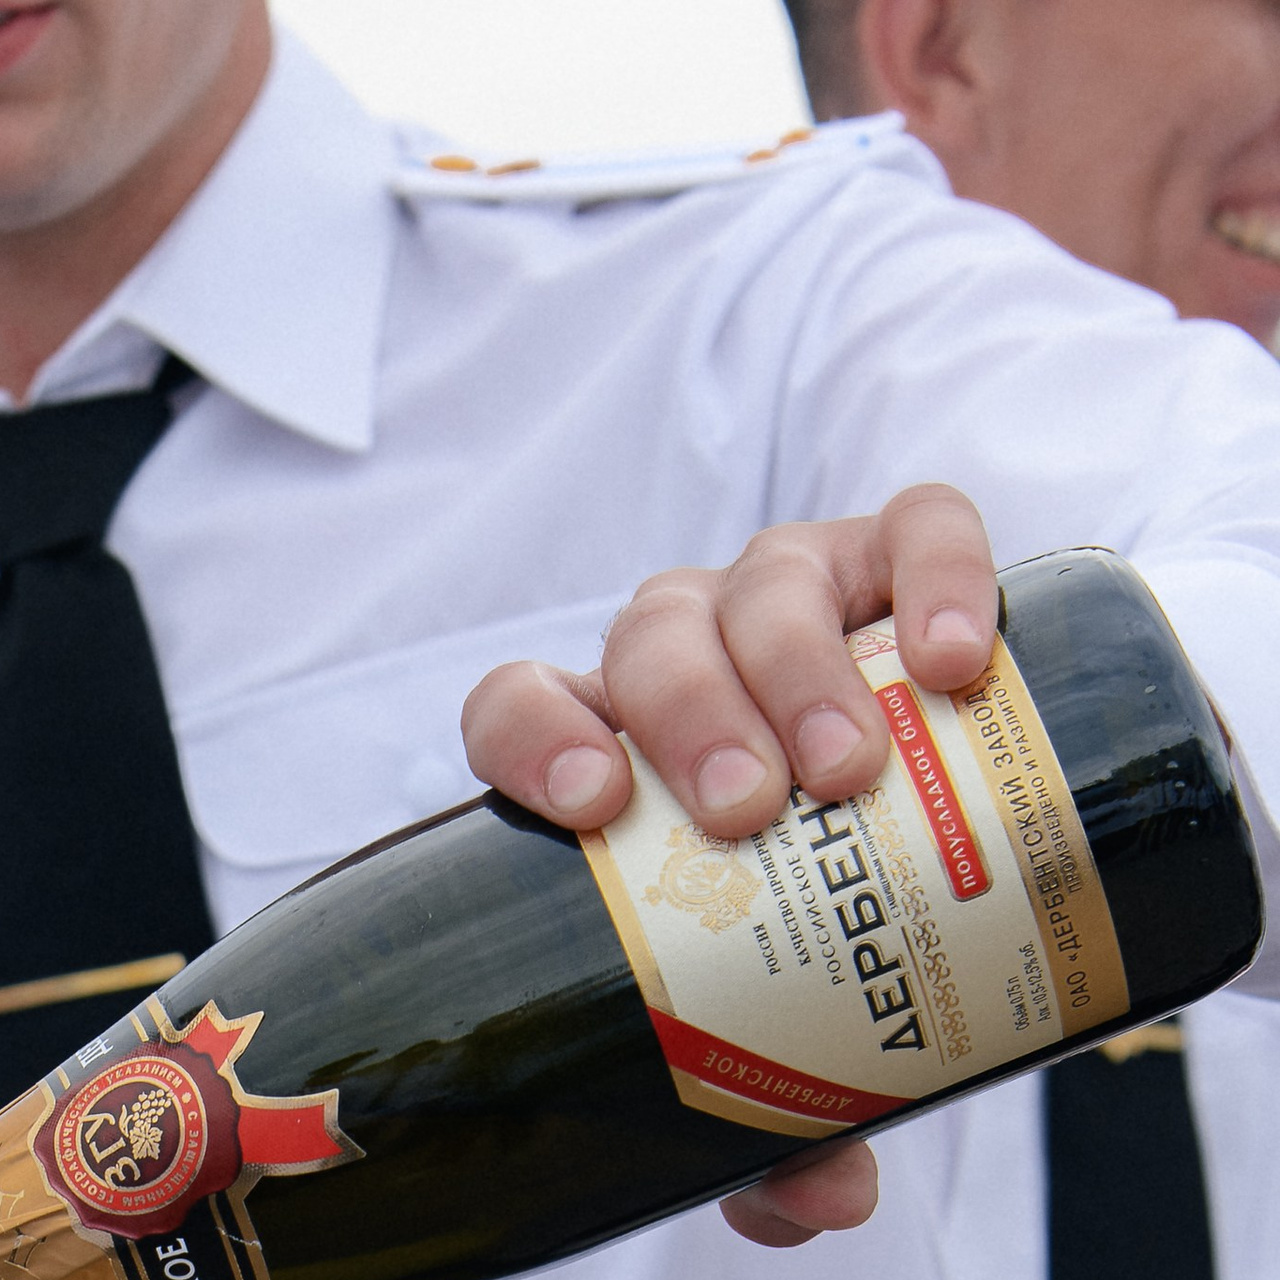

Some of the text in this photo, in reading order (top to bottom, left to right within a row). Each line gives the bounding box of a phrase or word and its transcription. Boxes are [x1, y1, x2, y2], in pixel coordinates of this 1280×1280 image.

[966, 688, 1014, 768] ЗАВОД
[993, 688, 1032, 755] РАЗЛИТО
[1024, 759, 1038, 771] И
[911, 746, 977, 889] ПОЛУСЛАДКОЕ
[1031, 776, 1082, 893] ПРОИЗВЕДЕНО
[750, 831, 811, 966] КАЧЕСТВО ПРОВЕРЕН
[786, 854, 845, 986] РОССИЙСКОЕ
[790, 784, 928, 1053] ДЕРБЕН
[753, 922, 781, 975] РОССИЯ
[1007, 984, 1025, 1005] 0,75
[1066, 970, 1090, 1009] ОАО
[106, 1063, 182, 1088] УКАЗАНИЕМ
[702, 1050, 854, 1111] ДЕРБЕНТСКОЕ
[78, 1112, 141, 1191] ЗГУ
